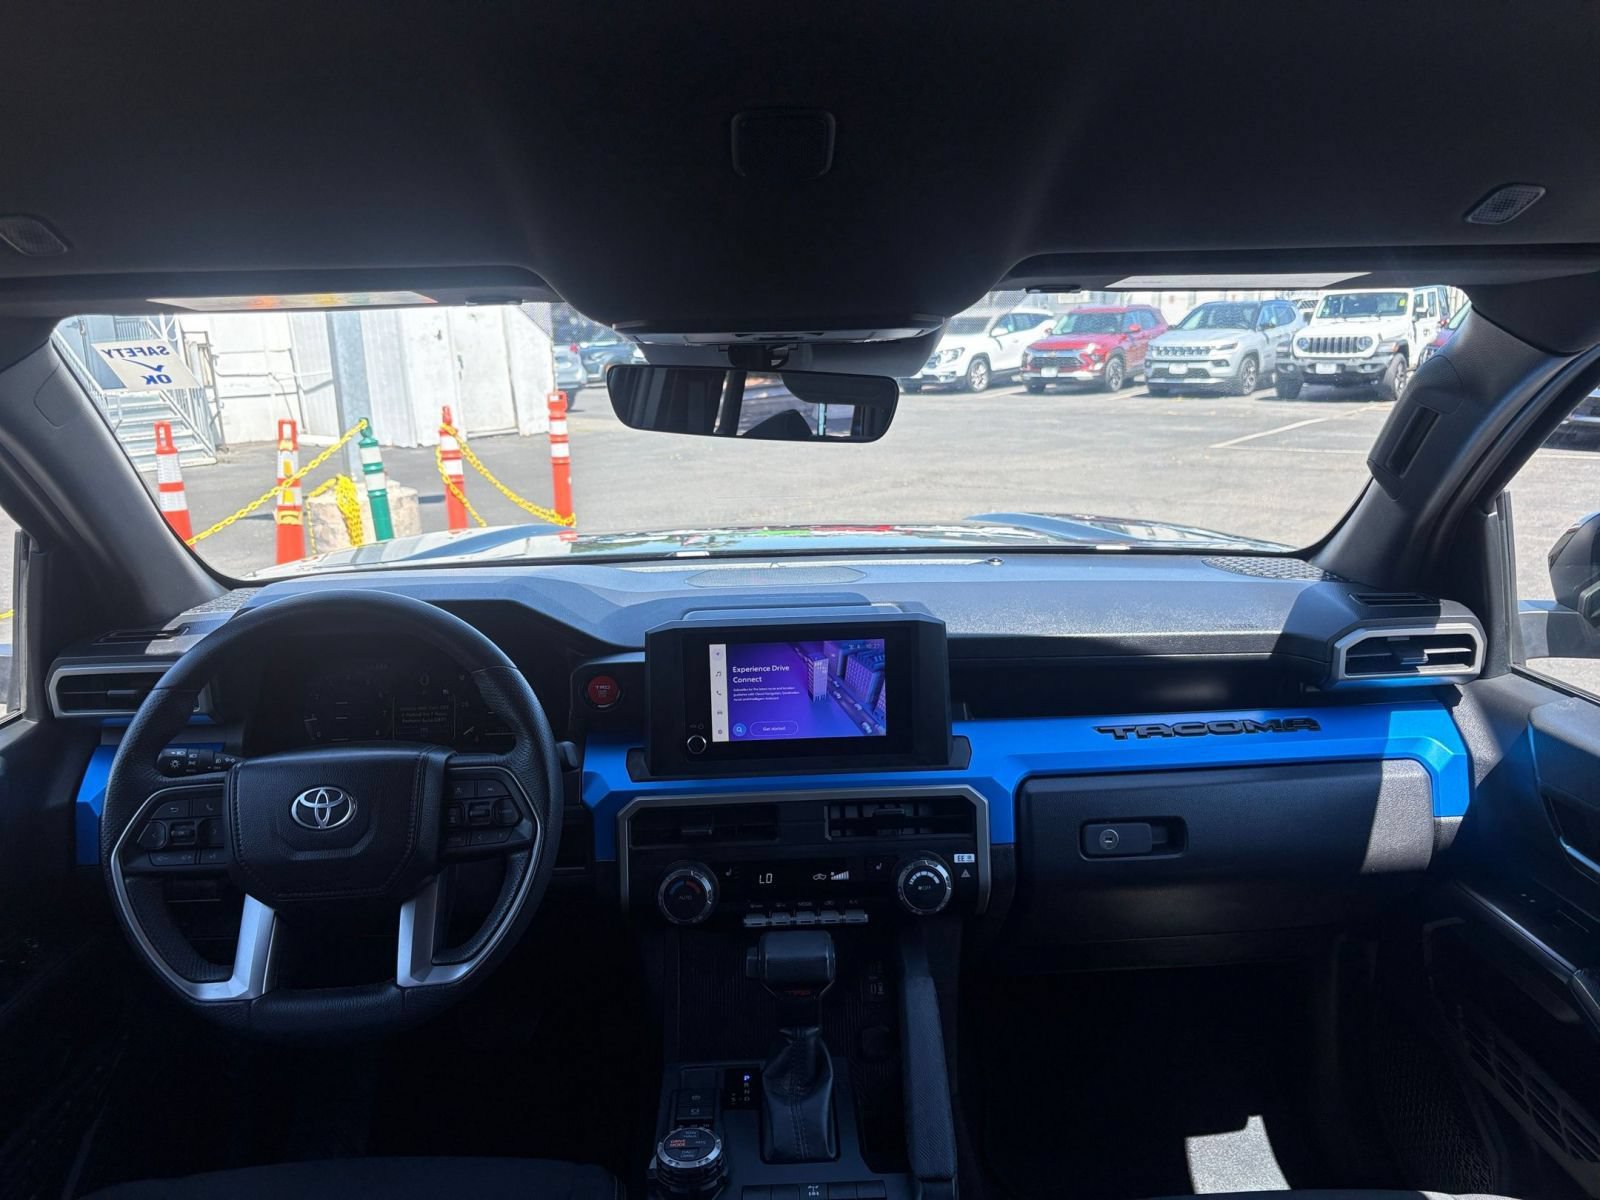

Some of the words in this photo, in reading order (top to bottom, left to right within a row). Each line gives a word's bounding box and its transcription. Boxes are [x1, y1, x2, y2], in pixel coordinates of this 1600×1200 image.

[732, 666, 771, 674] Experience
[733, 676, 763, 684] Connect
[1093, 717, 1321, 740] TACOMA
